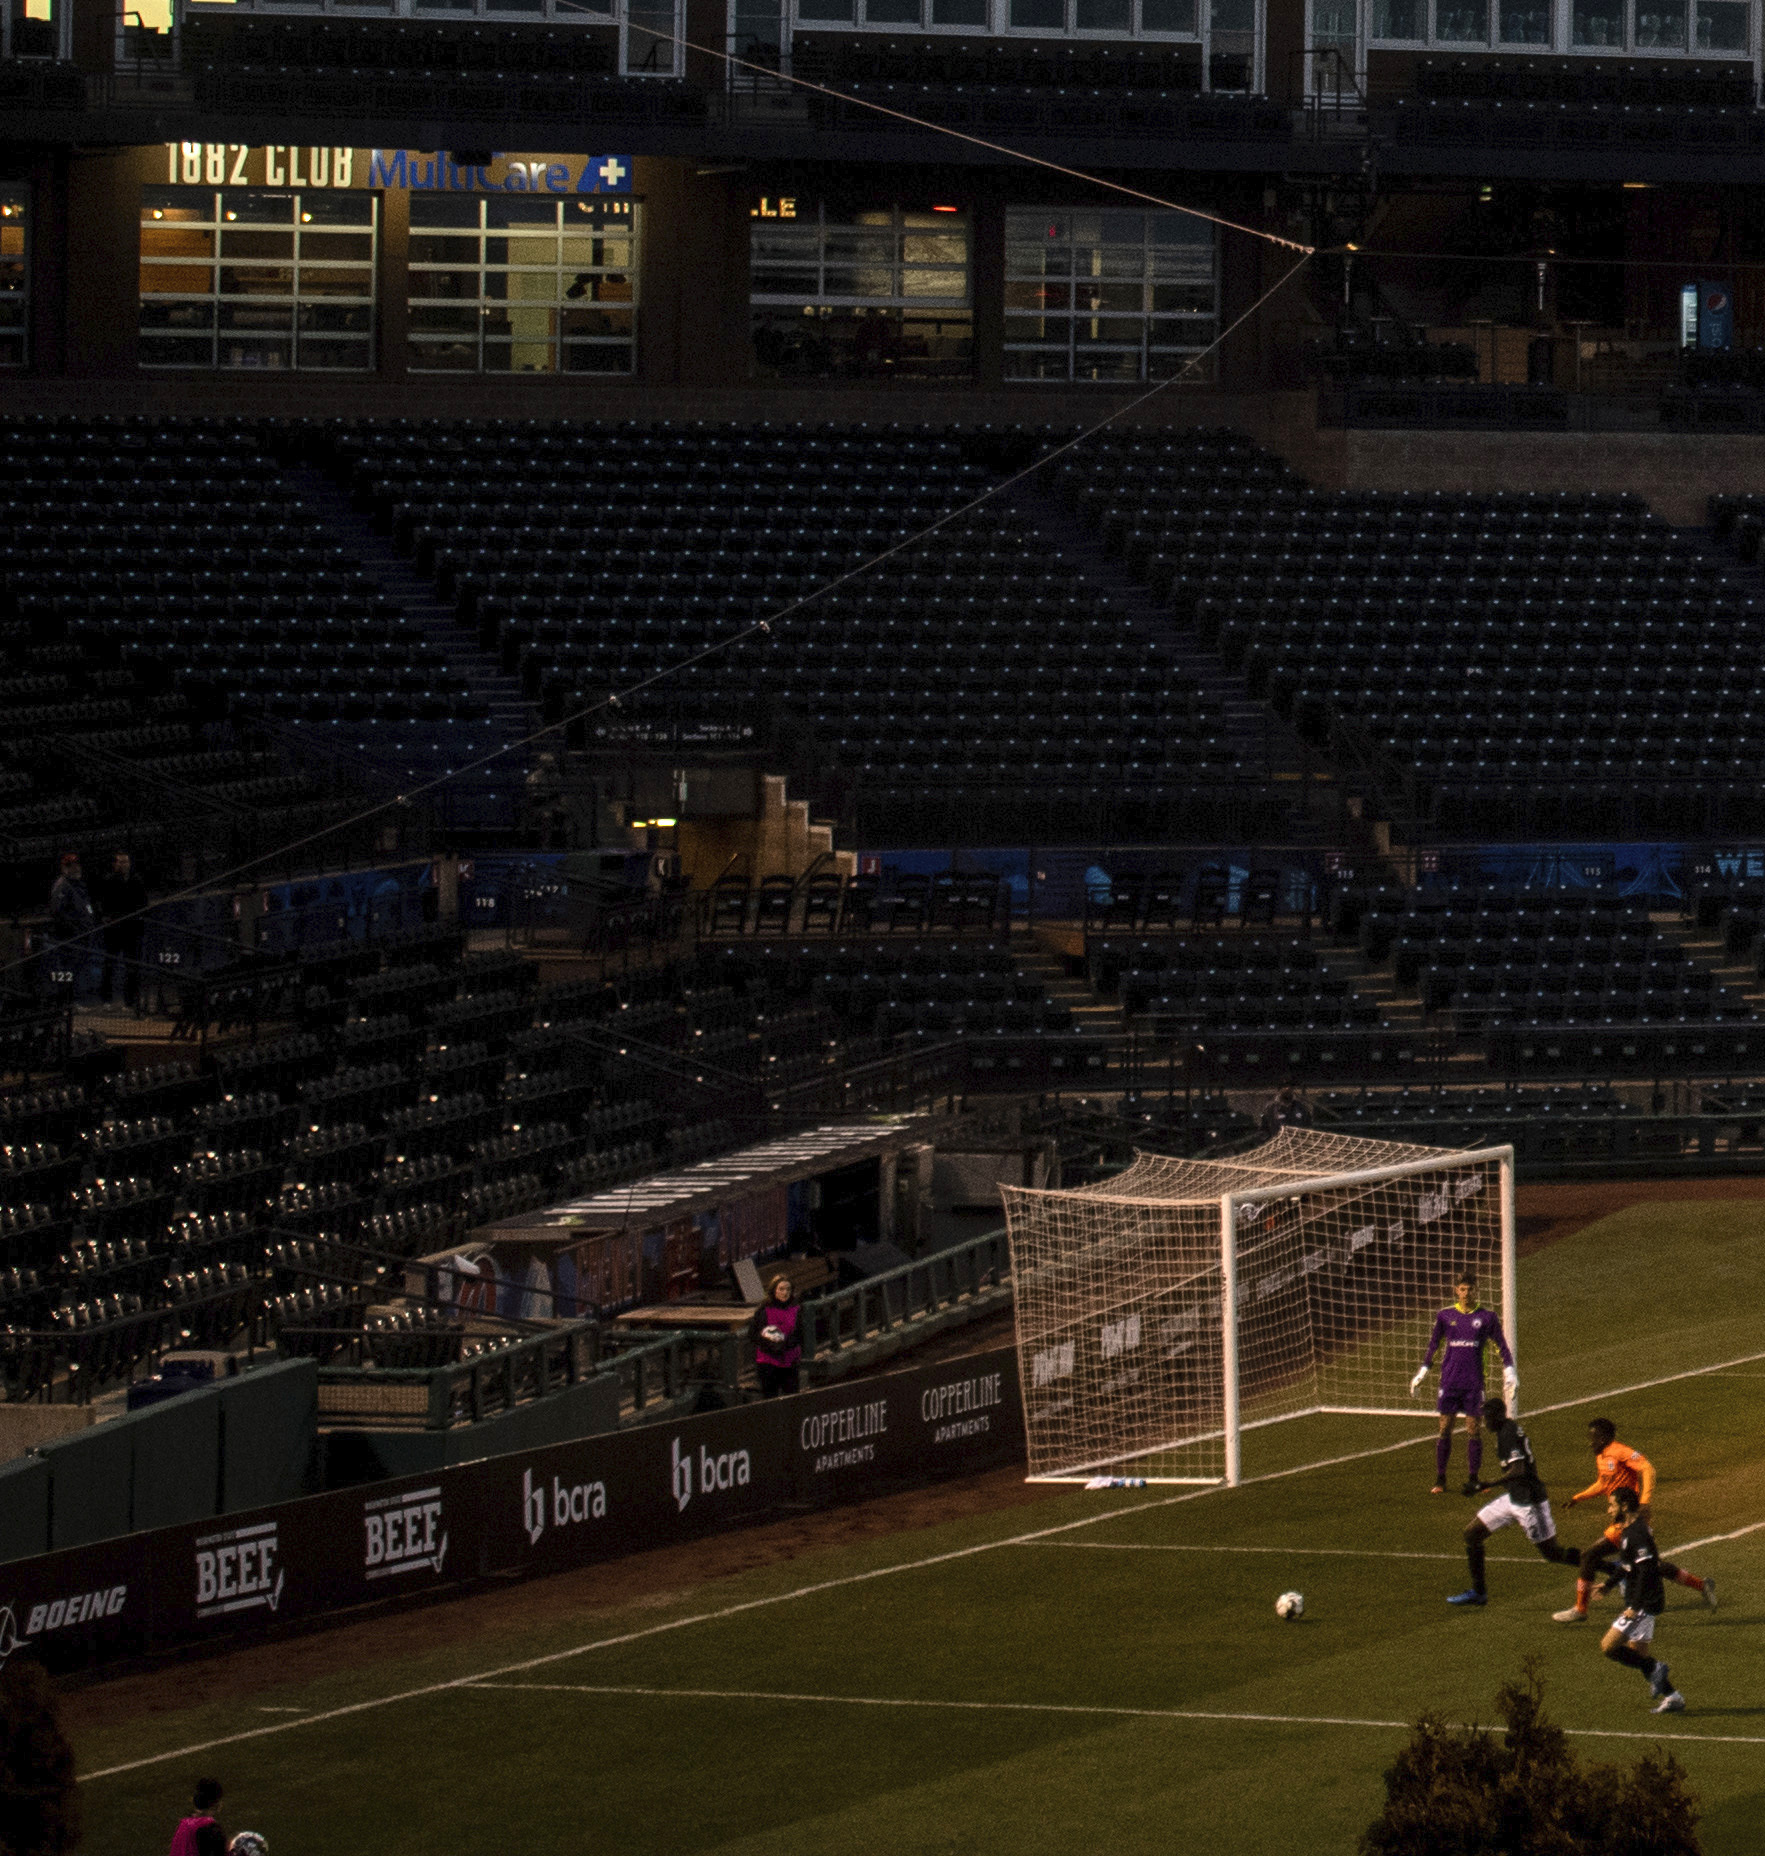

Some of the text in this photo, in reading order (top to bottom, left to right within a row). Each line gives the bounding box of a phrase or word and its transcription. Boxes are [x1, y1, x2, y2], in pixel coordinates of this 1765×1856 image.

[165, 142, 352, 187] 1882 CLUB
[368, 147, 569, 193] MultiCare
[1714, 850, 1763, 877] WE
[923, 1374, 1001, 1422] COPPERLINE
[800, 1400, 887, 1450] COPPERLINE
[934, 1415, 990, 1443] APARTMENTS
[699, 1444, 751, 1494] bcra
[815, 1444, 875, 1473] APARTMENTS
[552, 1476, 606, 1527] bcra
[364, 1502, 441, 1565] BEEF
[196, 1538, 277, 1603] BEEF
[25, 1585, 127, 1635] BOEING
